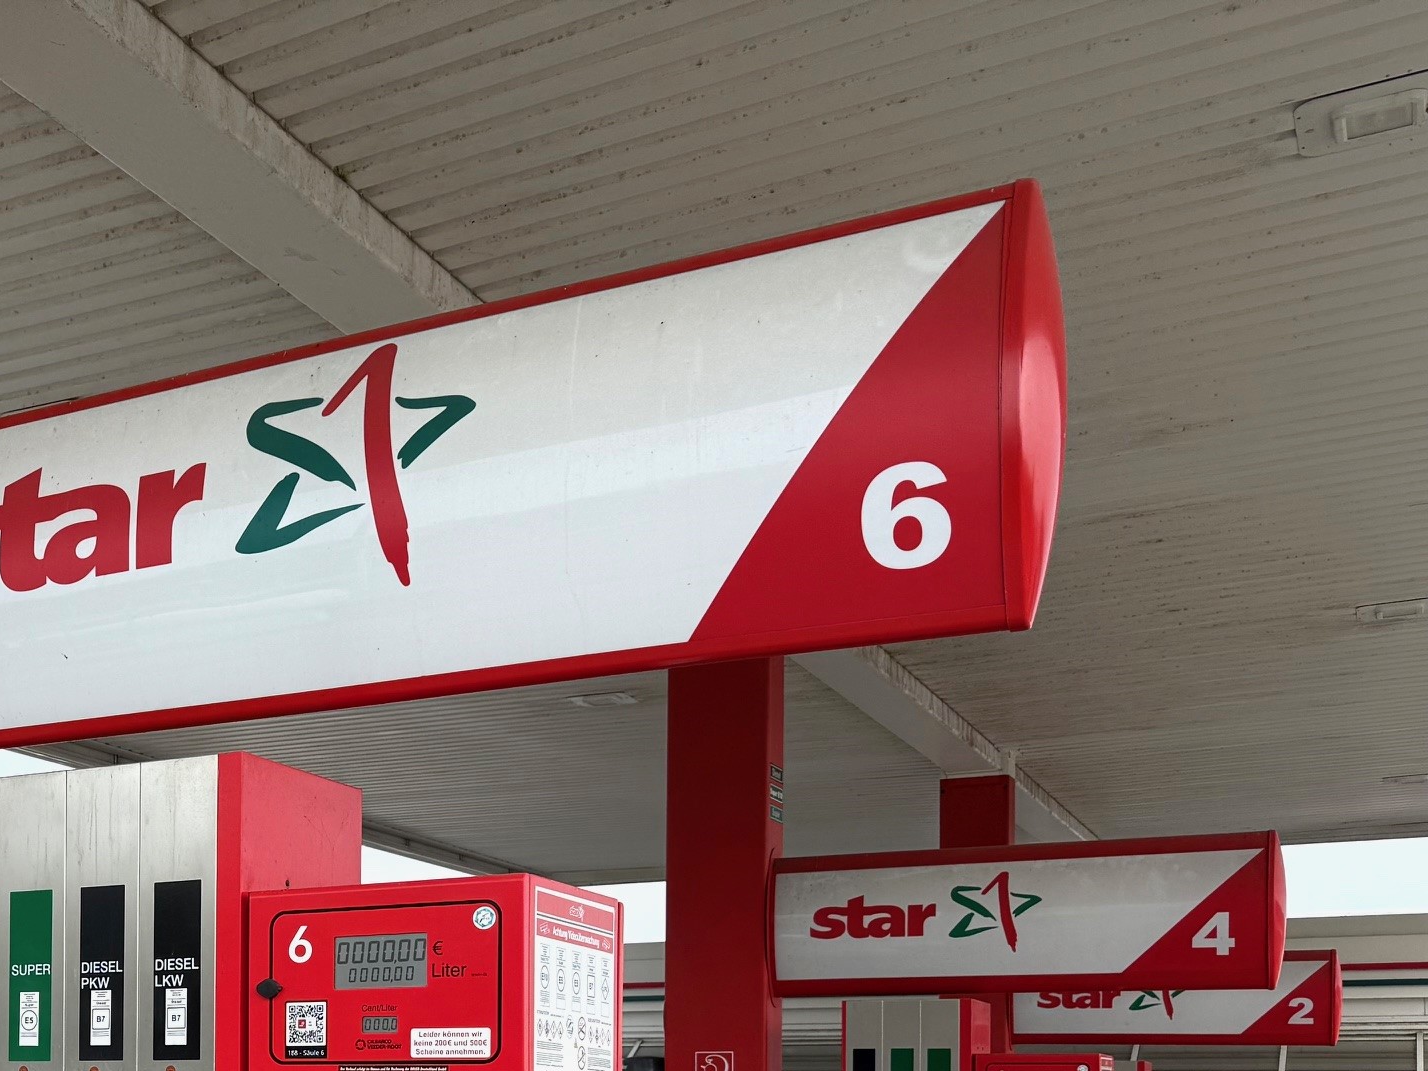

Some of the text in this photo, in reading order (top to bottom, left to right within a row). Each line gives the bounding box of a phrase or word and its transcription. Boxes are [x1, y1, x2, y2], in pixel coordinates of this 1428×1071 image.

[860, 461, 952, 570] 6
[809, 894, 937, 939] star
[1191, 911, 1236, 956] 4
[288, 925, 313, 964] 6
[432, 940, 444, 956] €
[11, 963, 51, 976] SUPER
[81, 961, 123, 974] DIESEL
[154, 957, 200, 971] DIESEL
[431, 962, 467, 978] Liter
[81, 976, 110, 990] PKW
[154, 974, 184, 987] LKW
[361, 1004, 398, 1012] Cent/Liter
[1287, 997, 1315, 1025] 2
[24, 1016, 34, 1024] E5
